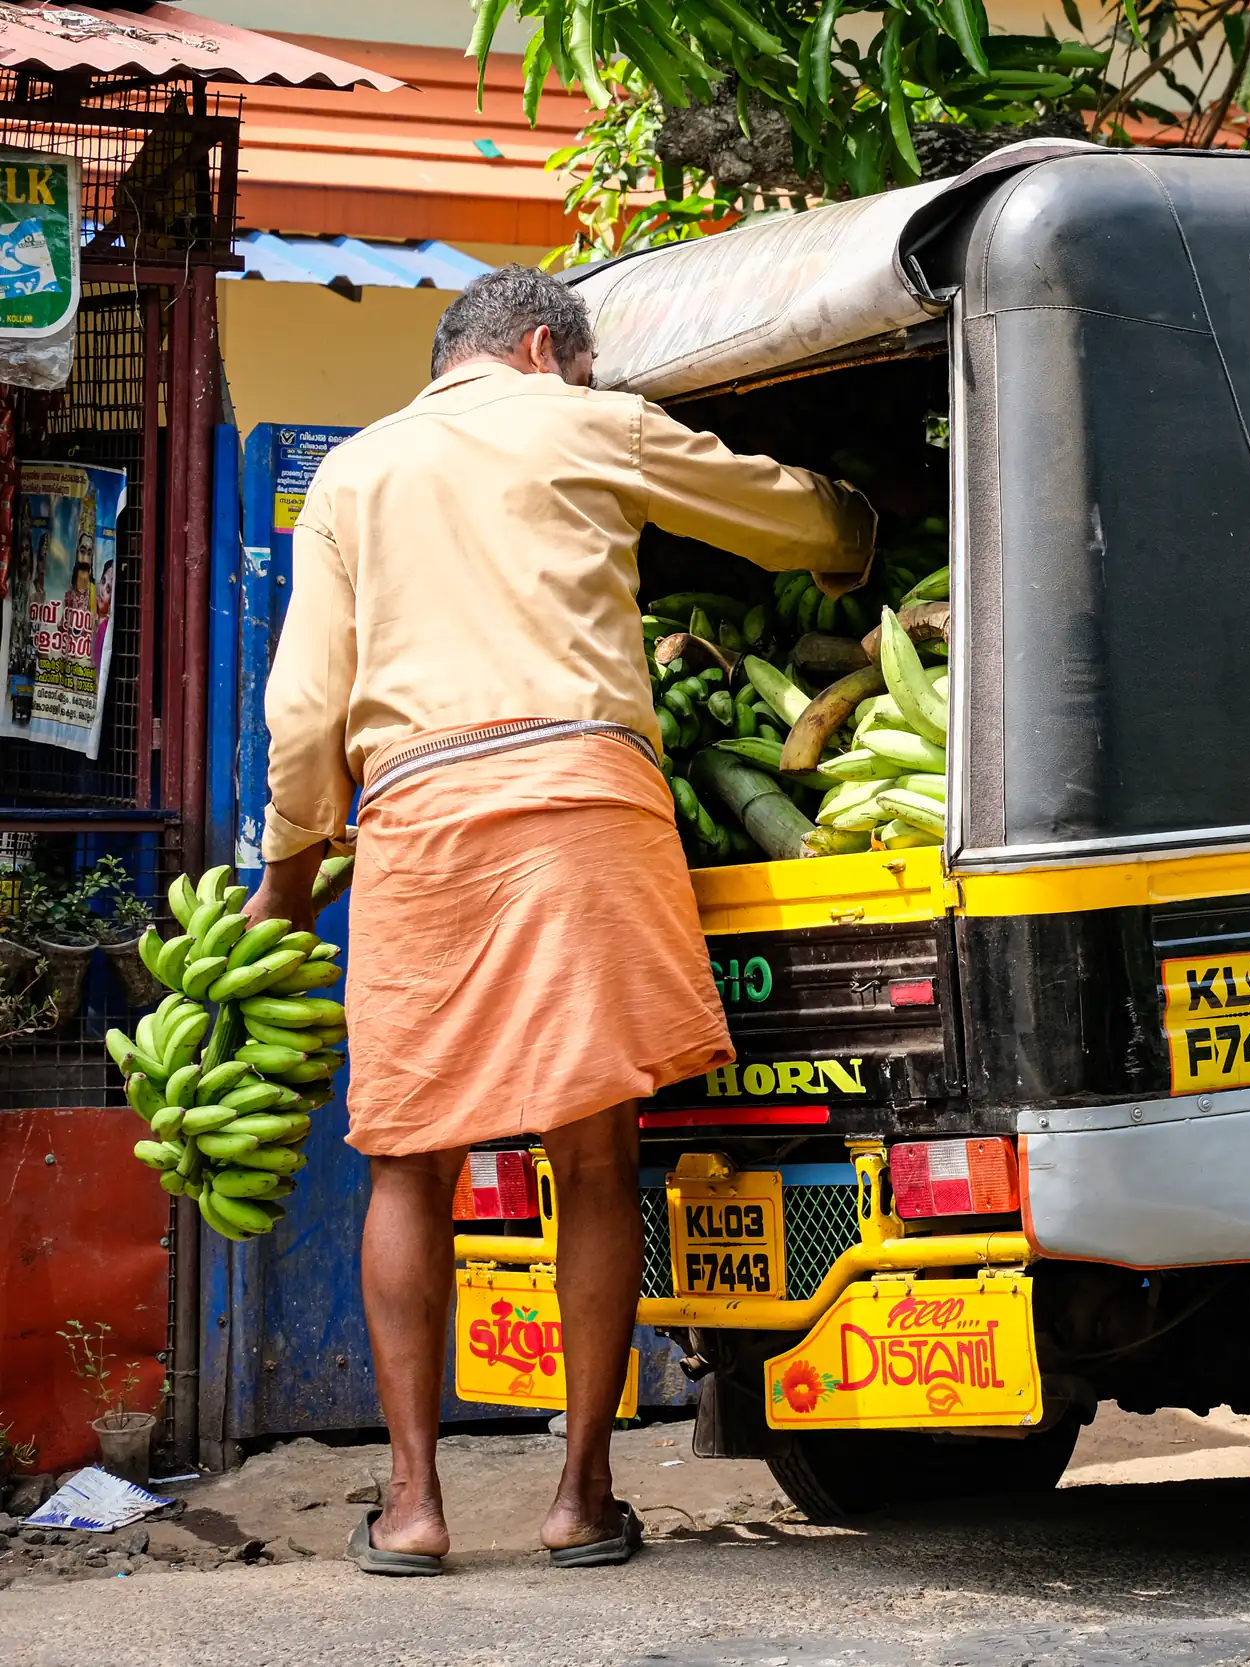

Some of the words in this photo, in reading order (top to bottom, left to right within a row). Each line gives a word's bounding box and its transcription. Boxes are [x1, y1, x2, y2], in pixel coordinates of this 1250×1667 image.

[0, 167, 55, 205] LK
[6, 314, 34, 324] KOLLAM
[706, 1058, 867, 1097] HORN
[686, 1253, 770, 1292] F7443
